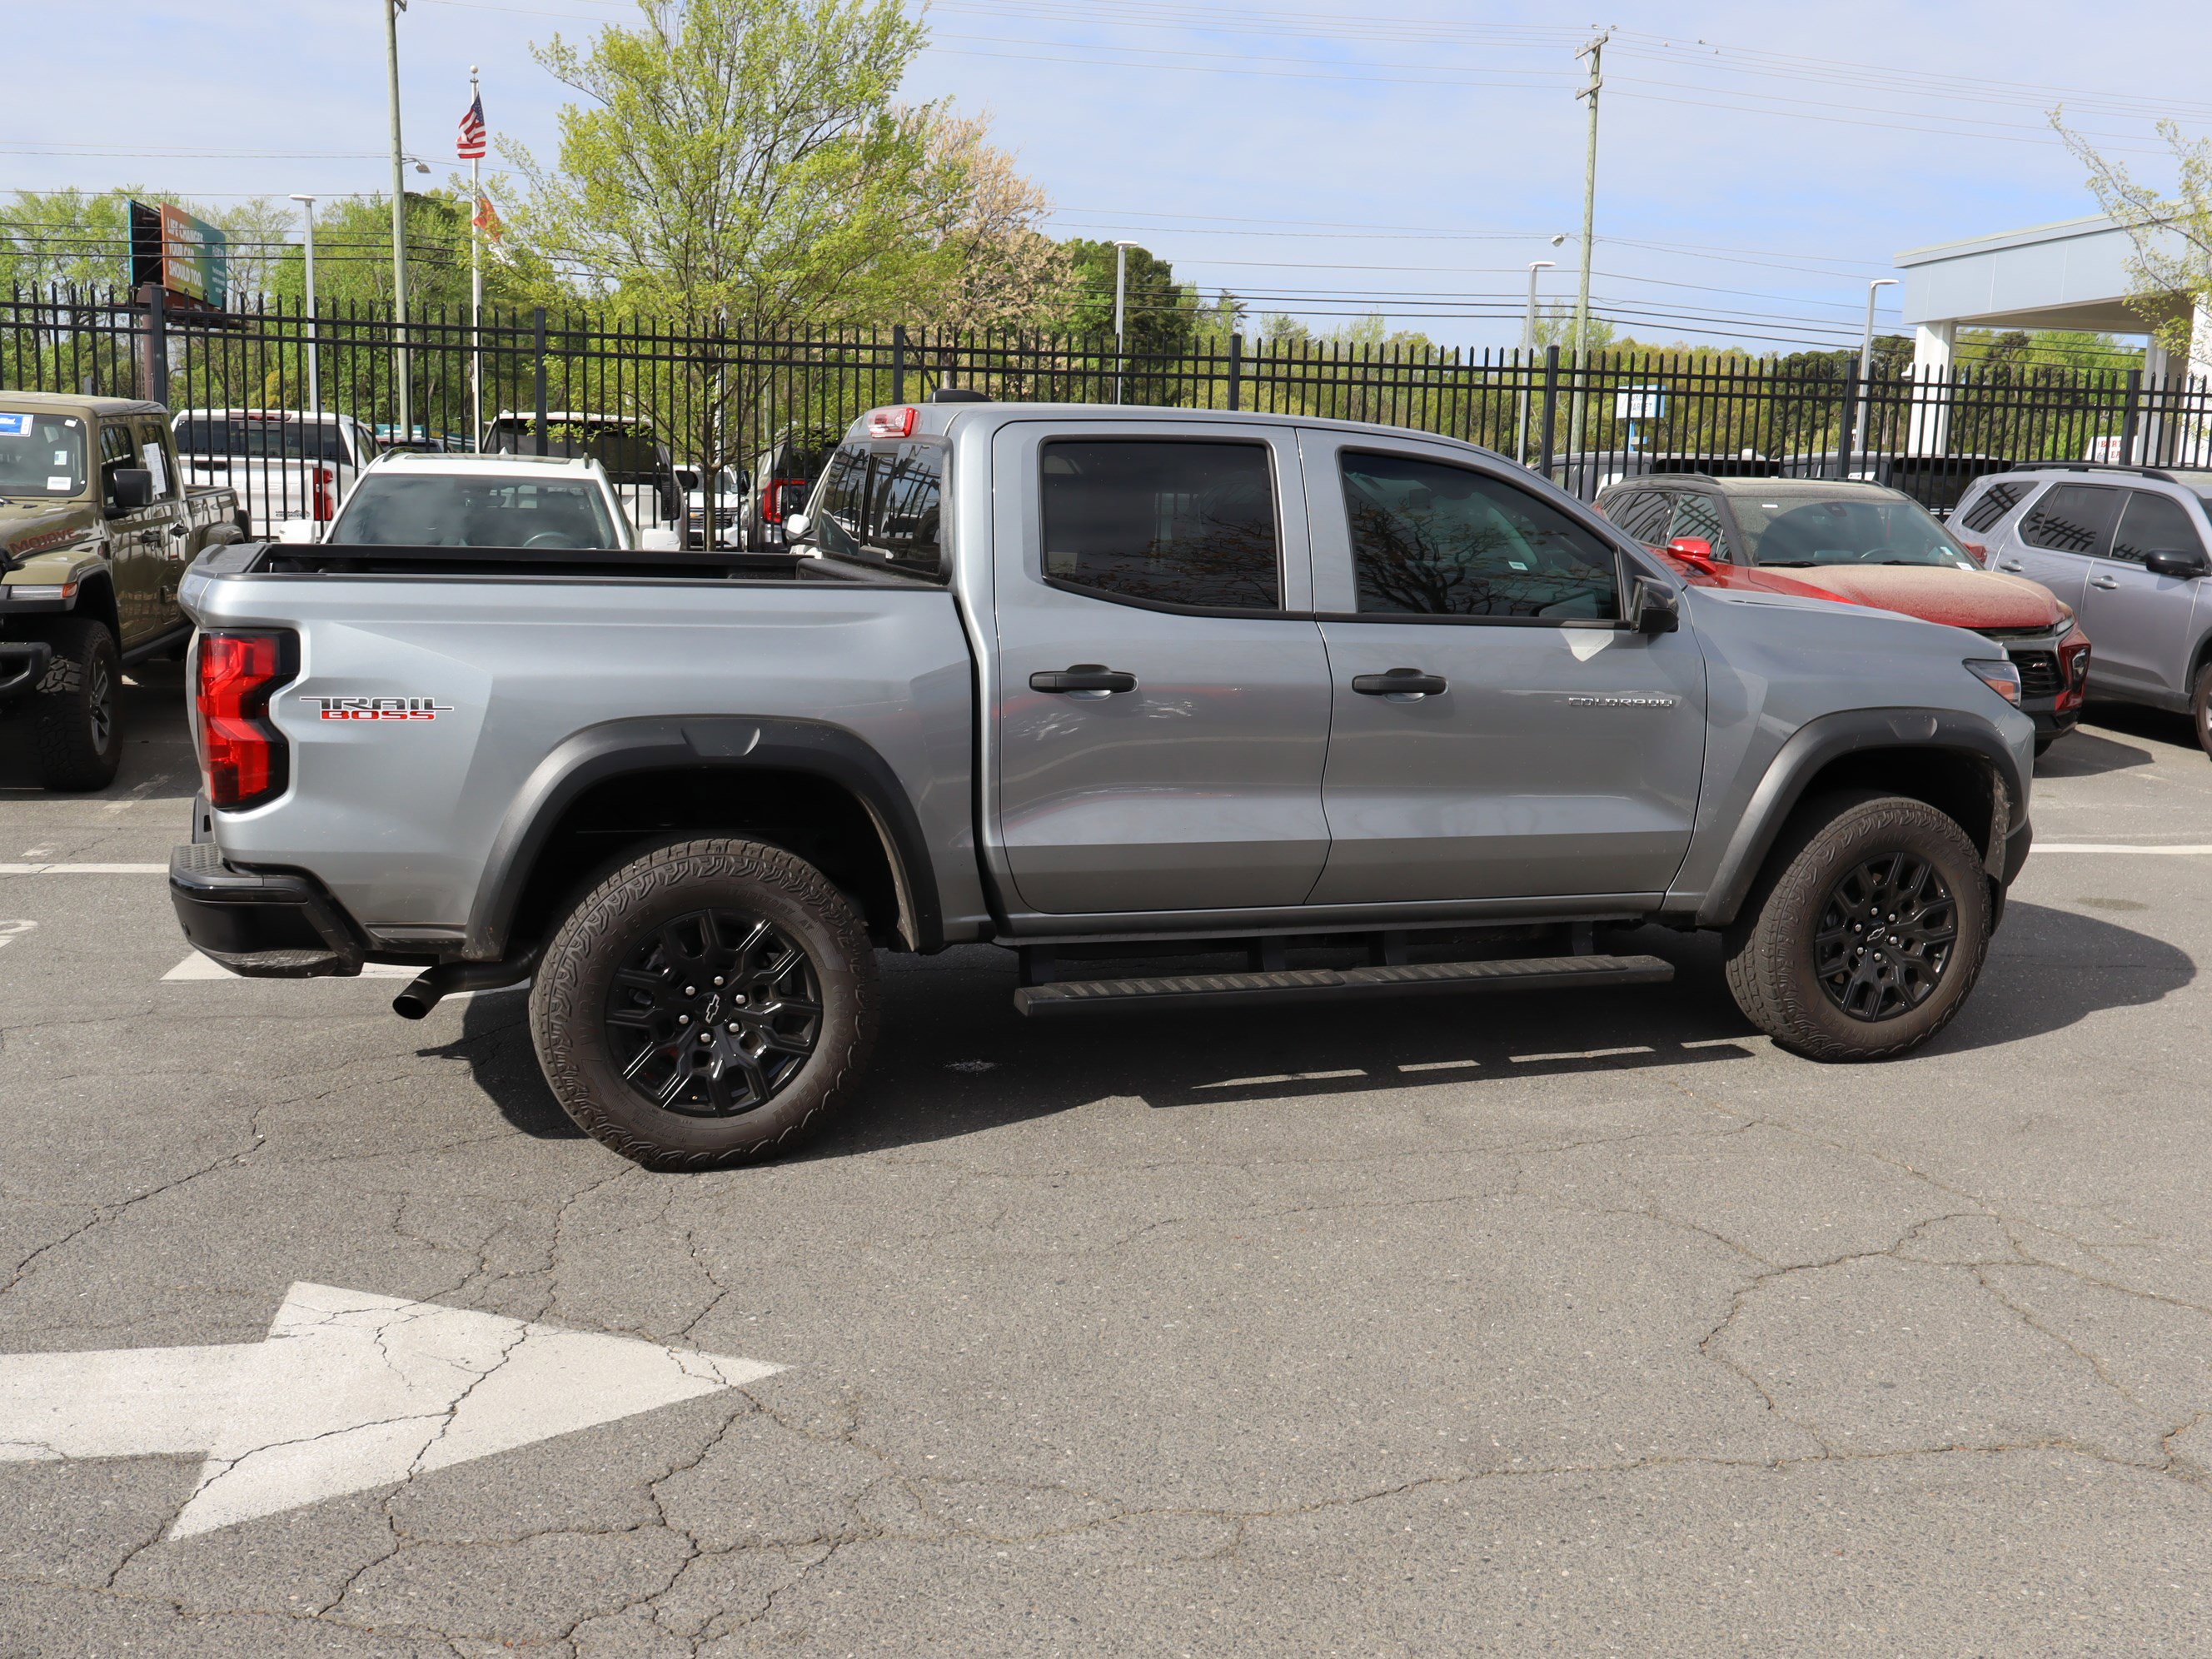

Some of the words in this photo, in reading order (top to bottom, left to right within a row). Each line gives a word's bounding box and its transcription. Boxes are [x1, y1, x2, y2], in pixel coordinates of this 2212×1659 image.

[167, 217, 178, 237] LIFE
[168, 238, 183, 258] YOUR
[183, 246, 195, 264] CAR
[169, 260, 191, 282] SHOULD
[191, 268, 203, 287] TOO.
[300, 696, 454, 710] TRAIL
[1568, 697, 1674, 707] COLORADO
[321, 710, 436, 720] BOSS
